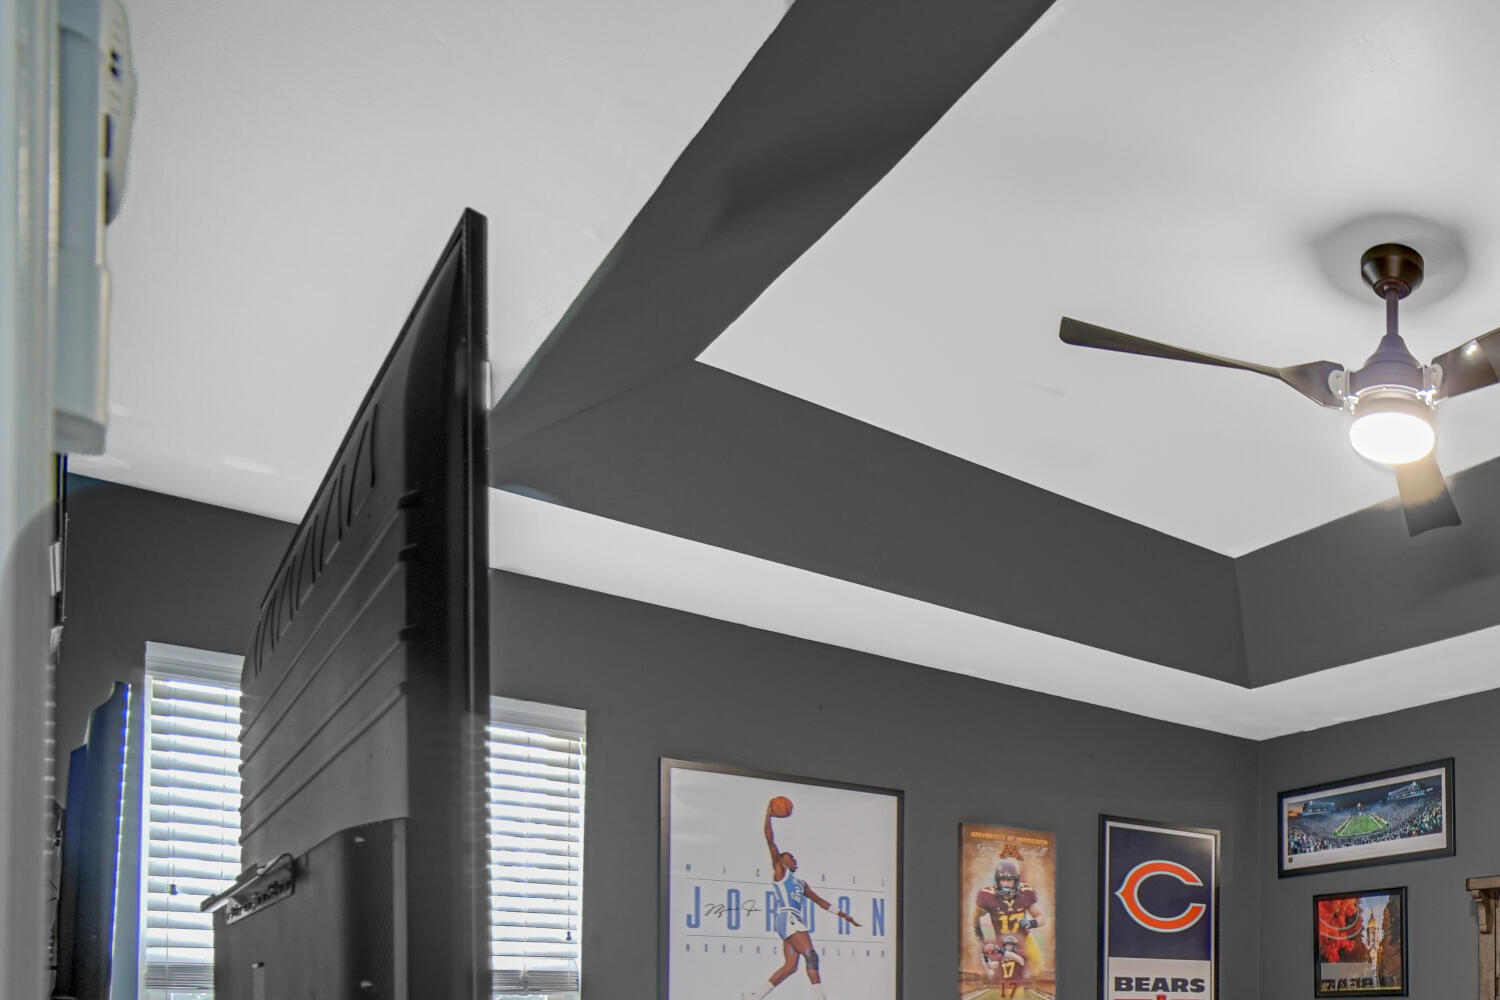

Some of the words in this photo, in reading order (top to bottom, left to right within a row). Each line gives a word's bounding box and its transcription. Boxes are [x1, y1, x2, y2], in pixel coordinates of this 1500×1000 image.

[998, 912, 1024, 934] 17
[1000, 981, 1017, 998] 17
[1114, 976, 1205, 993] BEARS
